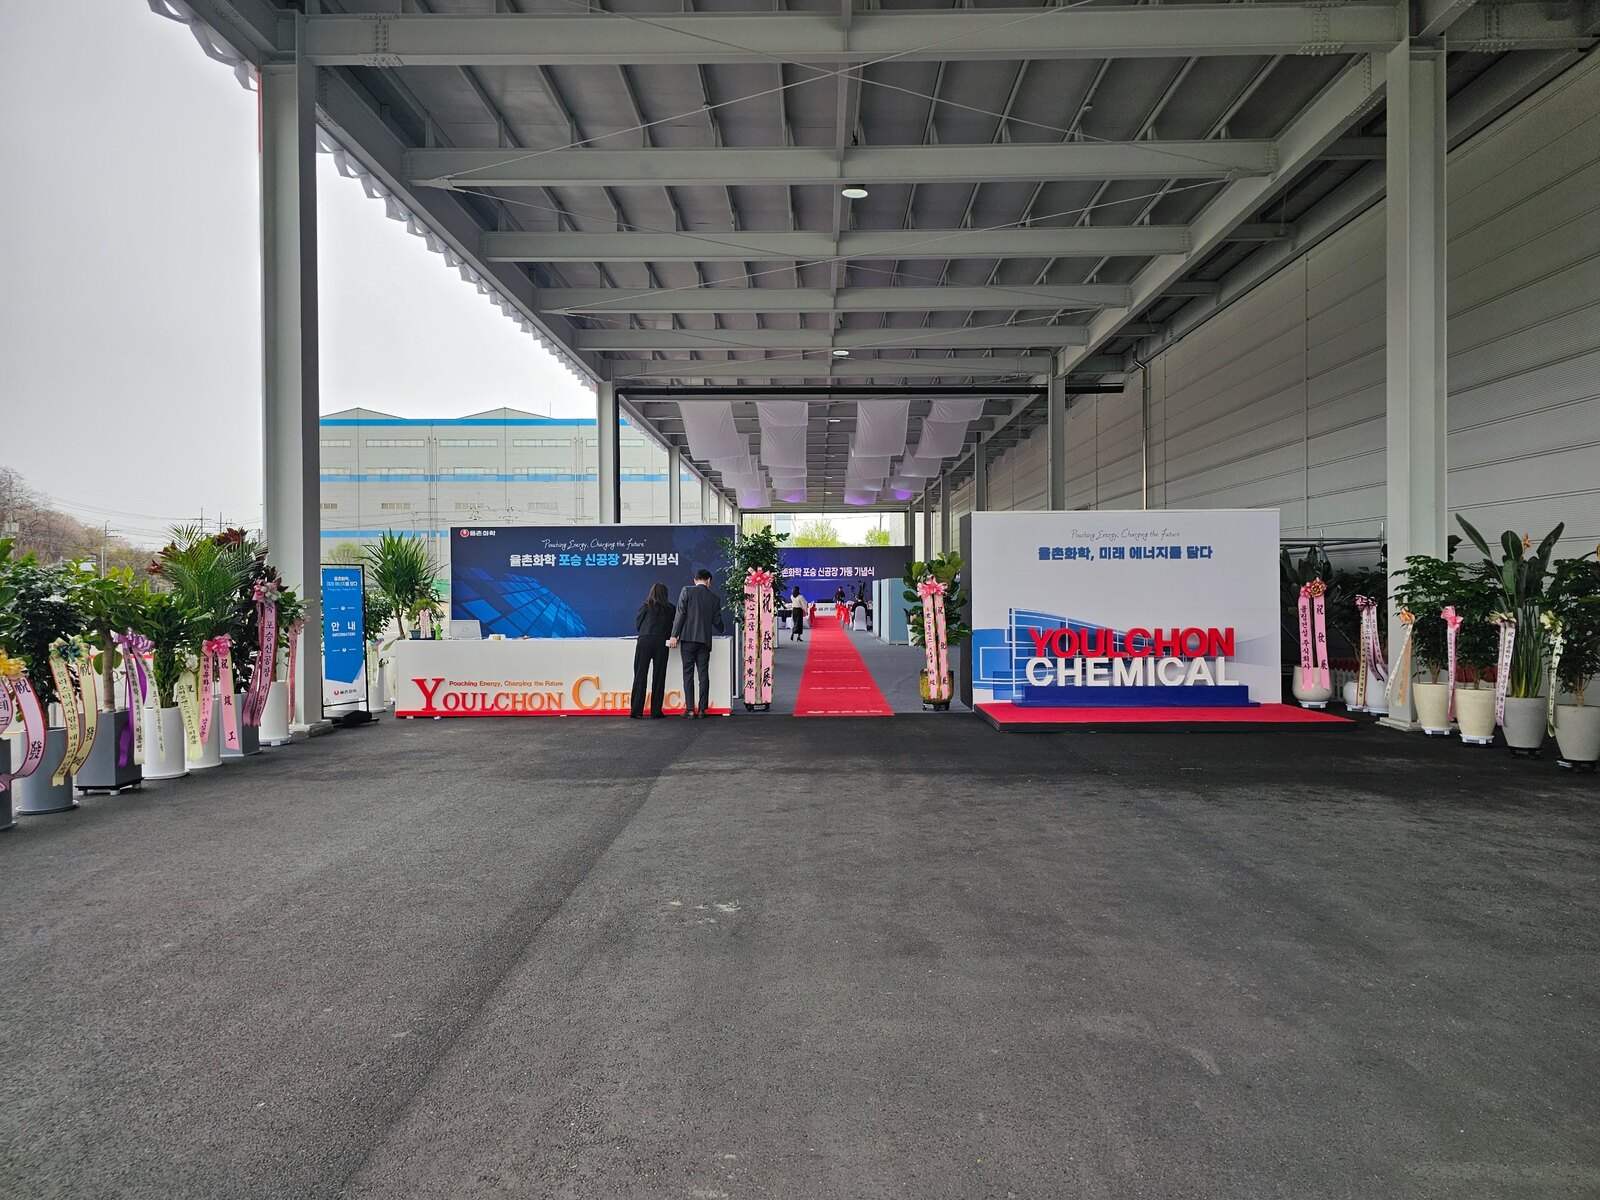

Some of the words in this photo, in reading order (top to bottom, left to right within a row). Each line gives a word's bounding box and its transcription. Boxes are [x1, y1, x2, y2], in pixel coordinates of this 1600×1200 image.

[1071, 529, 1095, 541] Pouching
[1120, 528, 1148, 541] Charging
[1160, 528, 1180, 541] Future
[590, 538, 615, 550] Charging
[1038, 546, 1095, 561] 율촌화학,
[1099, 546, 1125, 560] 미래
[1129, 546, 1182, 560] 에너지를
[1186, 545, 1213, 560] 담다
[509, 554, 557, 567] 율촌화학
[558, 554, 582, 567] 포승
[584, 553, 619, 567] 신공장
[803, 567, 816, 577] 포승
[818, 567, 838, 577] 신공장
[839, 567, 853, 577] 가동
[854, 566, 875, 577] 기념식
[1028, 627, 1235, 659] YOULCHON
[1025, 656, 1240, 687] CHEMICAL
[449, 680, 478, 688] Pouching
[479, 680, 503, 688] Energy,
[504, 680, 533, 688] Charging
